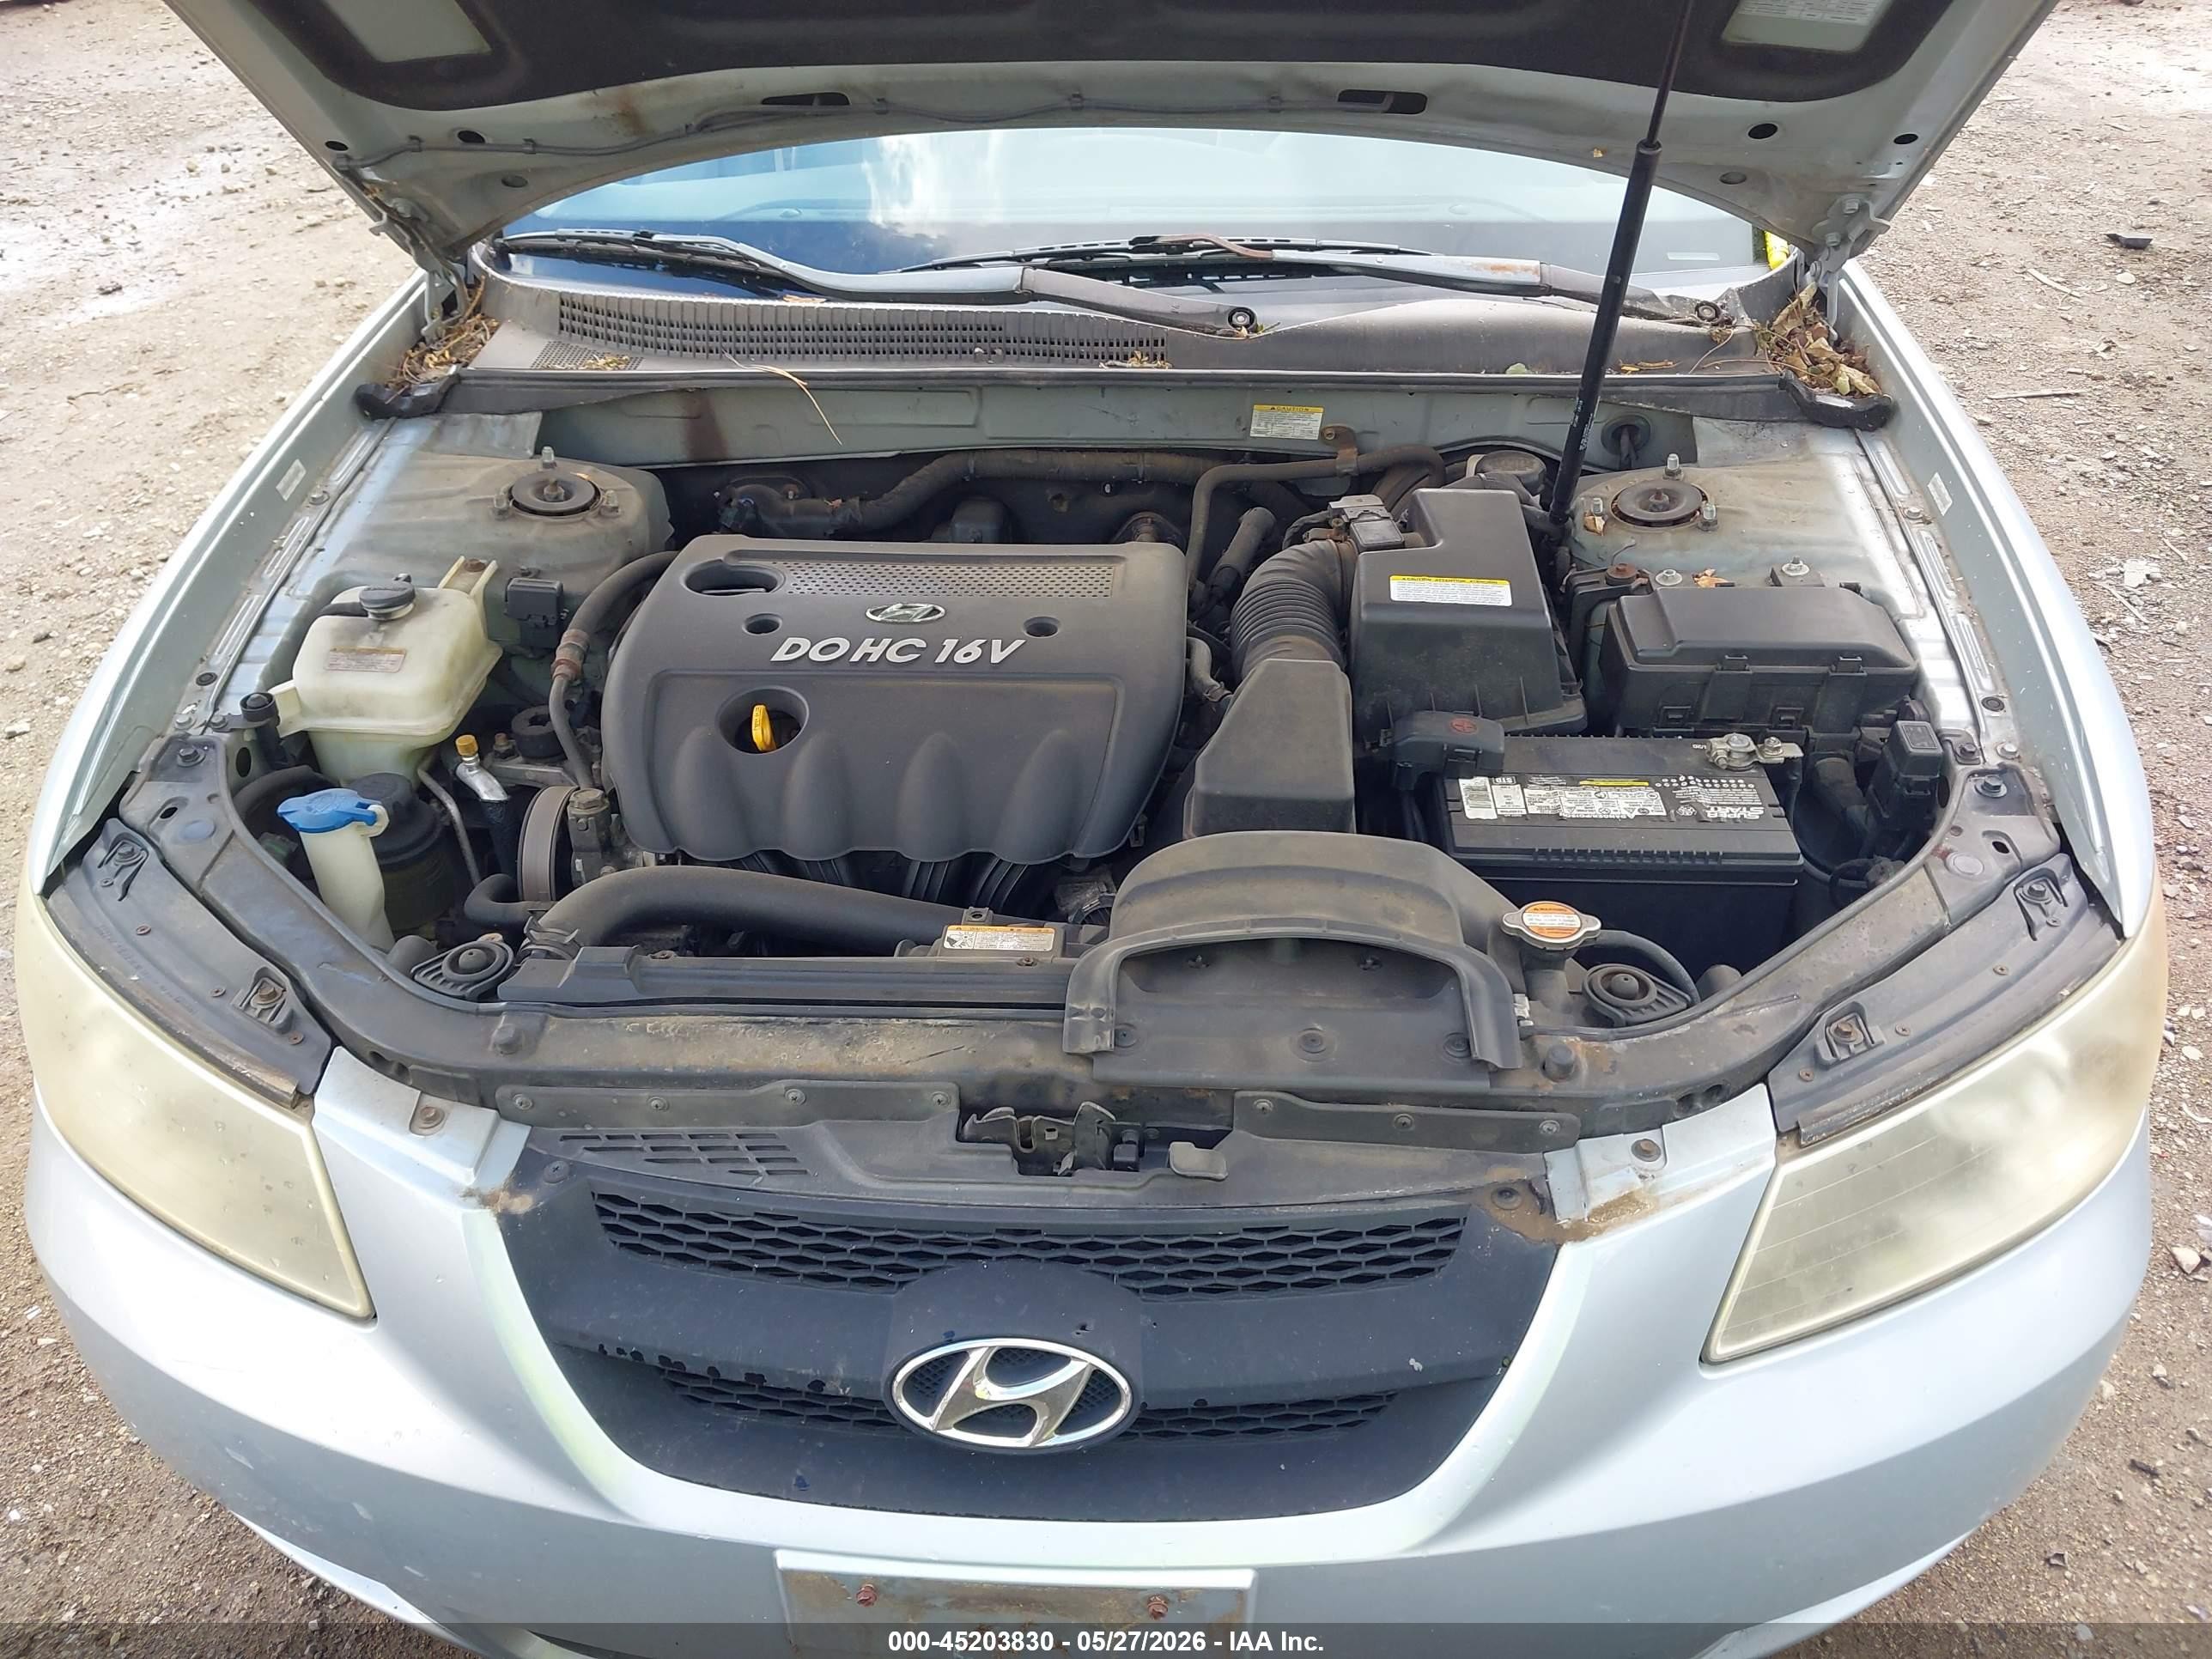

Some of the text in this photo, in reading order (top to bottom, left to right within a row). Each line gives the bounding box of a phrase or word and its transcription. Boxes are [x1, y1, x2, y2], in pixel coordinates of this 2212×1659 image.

[769, 637, 1027, 664] DOHC 16V
[1706, 805, 1765, 814] START
[1705, 811, 1760, 820] SUPER
